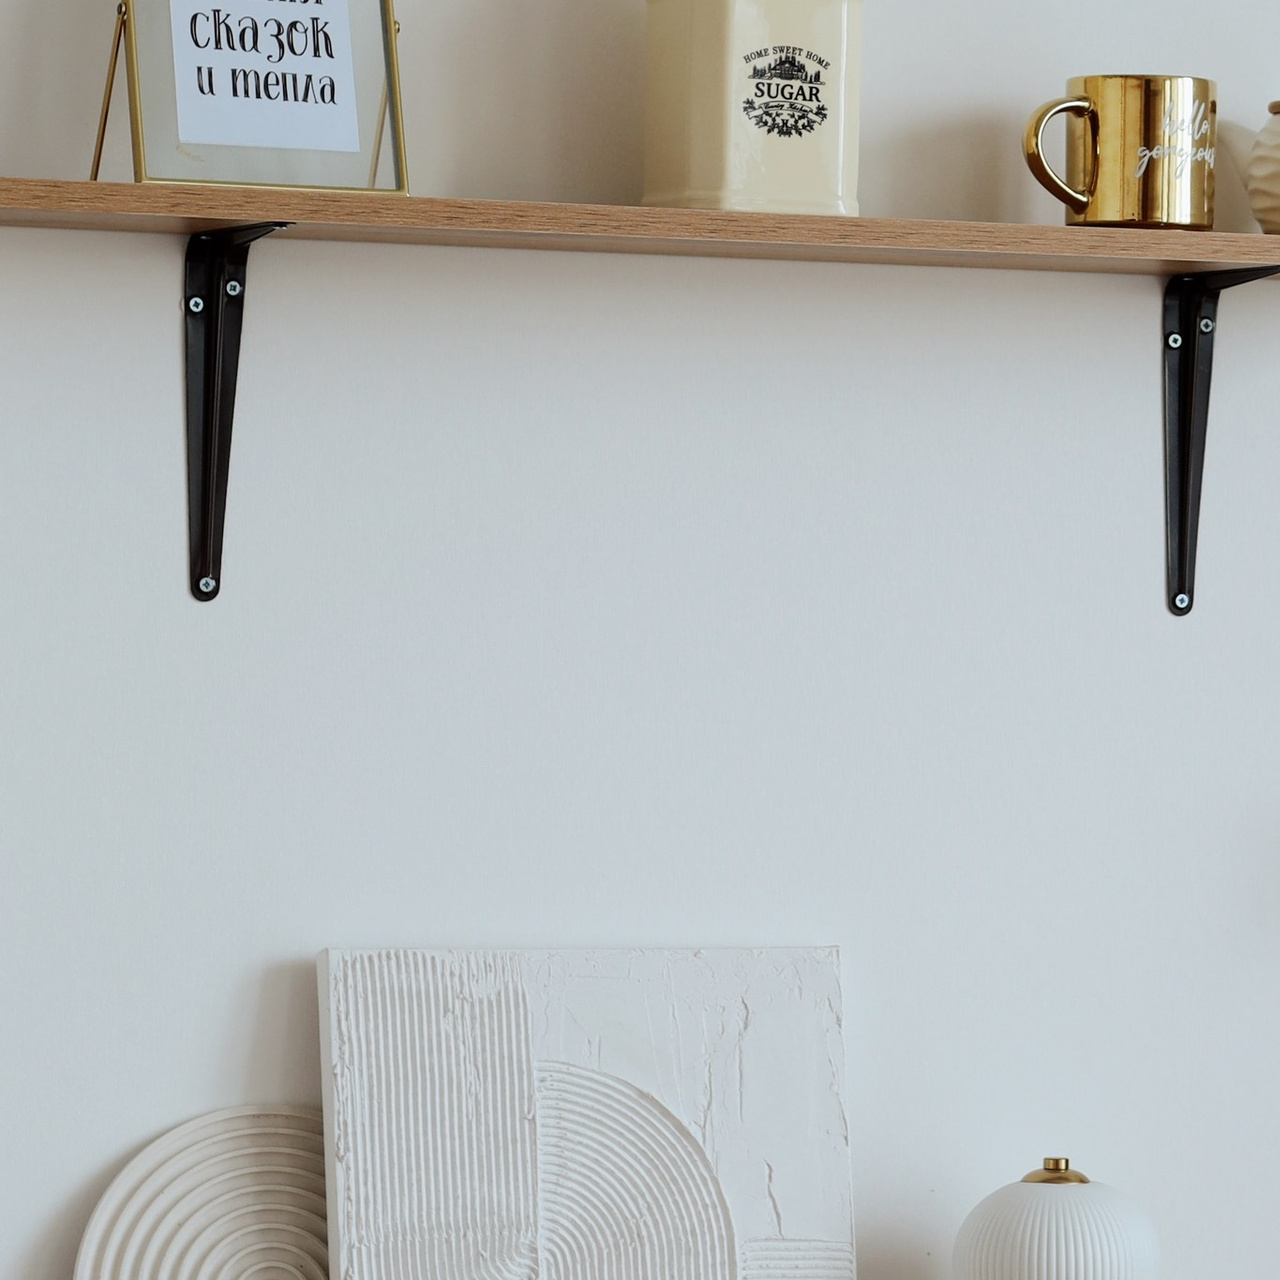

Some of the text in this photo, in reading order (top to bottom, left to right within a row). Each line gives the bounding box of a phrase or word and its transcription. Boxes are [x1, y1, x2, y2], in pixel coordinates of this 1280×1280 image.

[190, 9, 335, 63] сказок
[743, 45, 831, 70] HOME SWEET HOME
[196, 66, 338, 105] и тепла
[754, 81, 822, 103] SUGAR
[1162, 99, 1209, 140] hello
